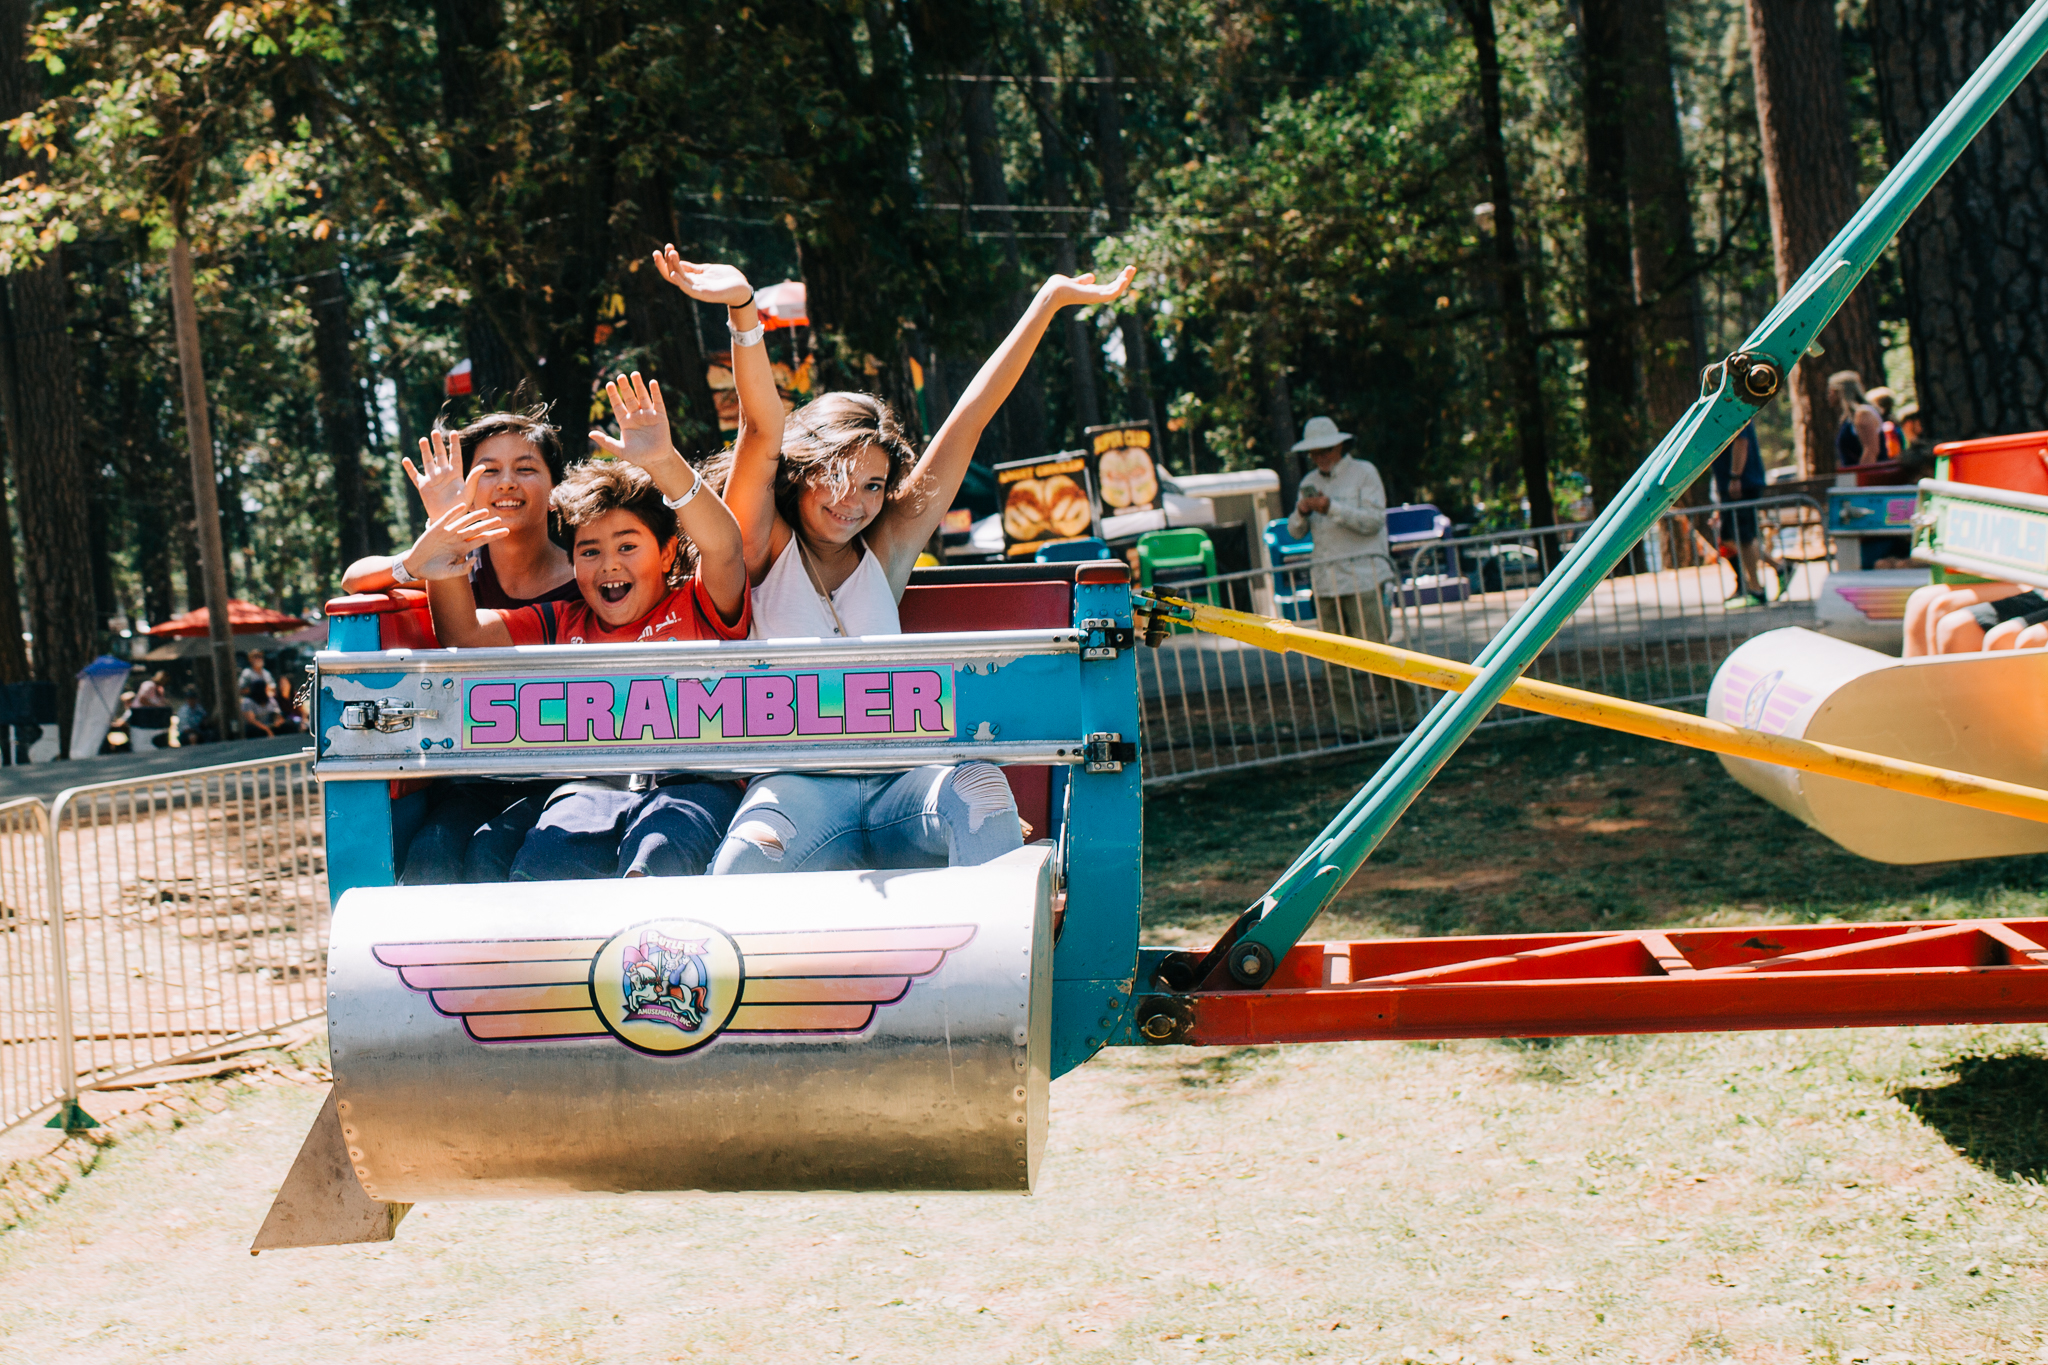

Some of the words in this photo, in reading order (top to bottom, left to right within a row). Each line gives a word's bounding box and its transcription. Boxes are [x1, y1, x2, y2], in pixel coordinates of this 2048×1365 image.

[469, 670, 950, 744] SCRAMBLER
[646, 930, 698, 954] BUTLER
[637, 1008, 679, 1021] AMUSEMENTS,
[679, 1016, 692, 1028] INC.
